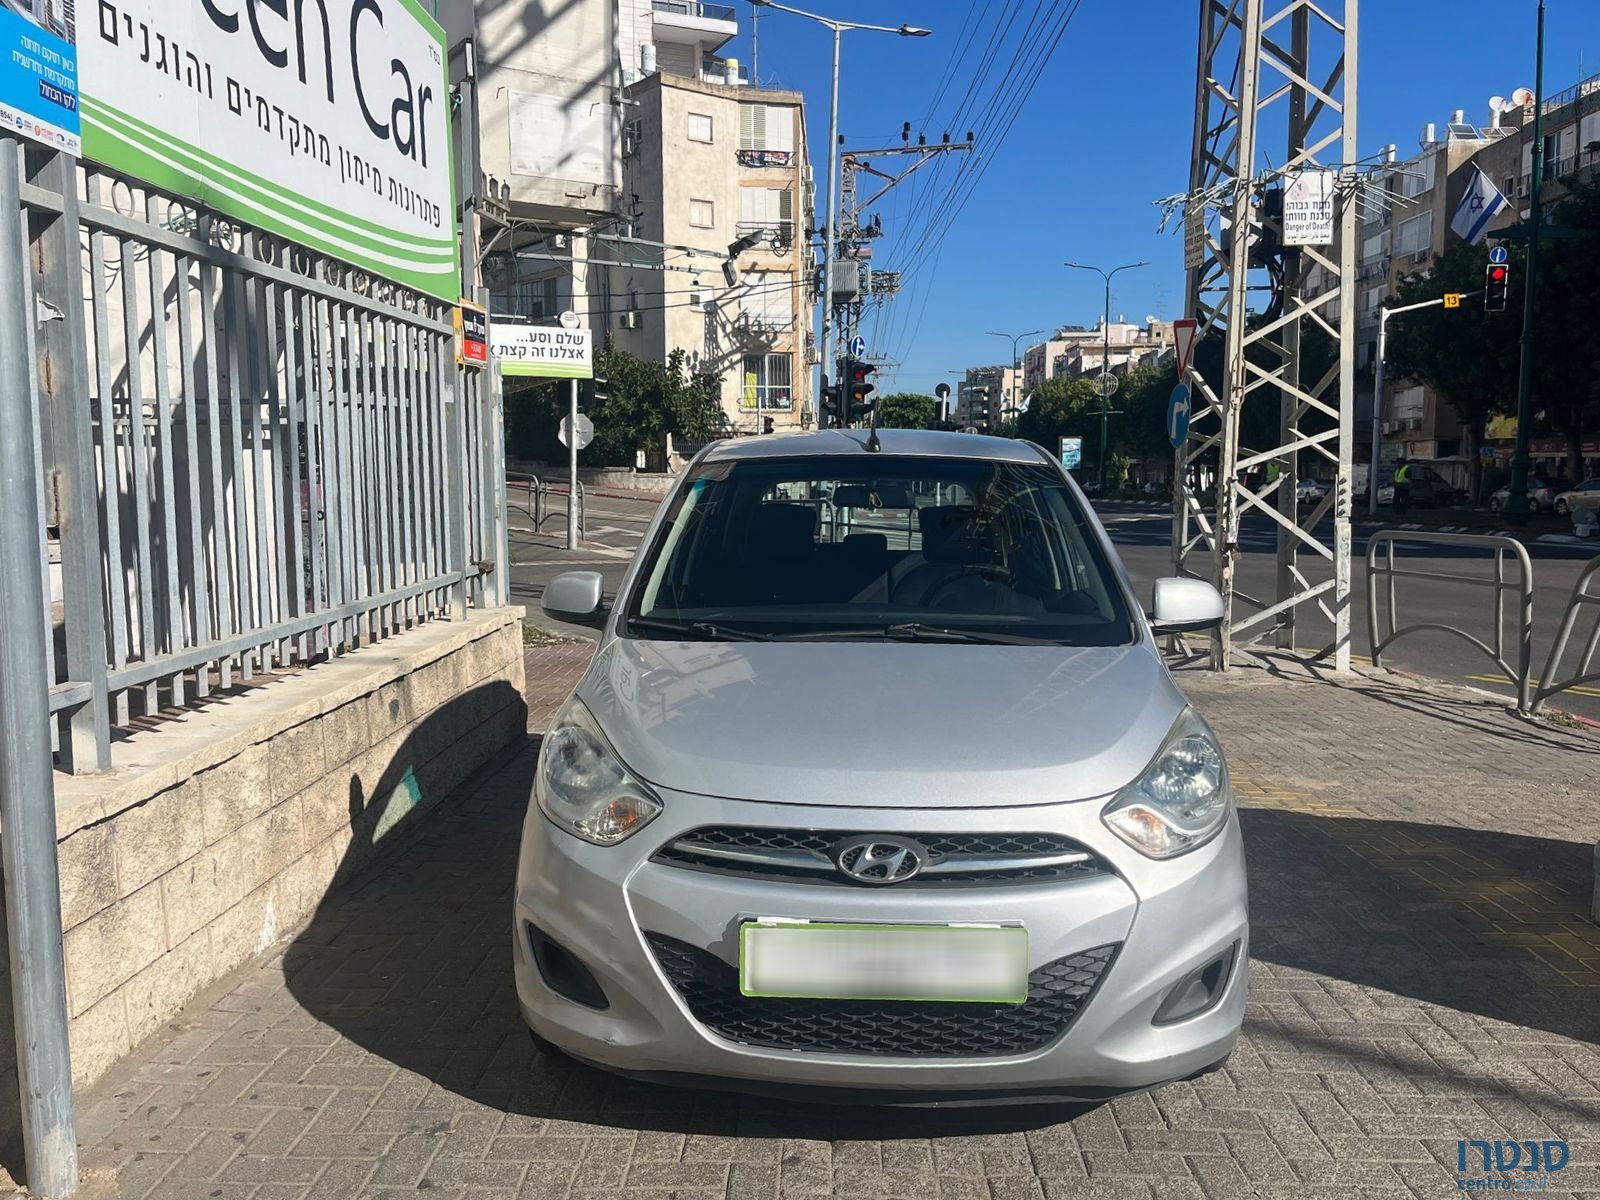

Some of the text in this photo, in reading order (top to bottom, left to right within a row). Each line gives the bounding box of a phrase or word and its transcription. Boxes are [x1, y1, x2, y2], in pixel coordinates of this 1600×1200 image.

[61, 56, 74, 71] כאן
[350, 0, 433, 168] Car
[40, 80, 76, 109] לקו הכחול
[98, 0, 441, 229] פתרונות מימון מתקדמים והוגנים
[1310, 211, 1331, 221] סכנת
[1285, 222, 1305, 232] Danger
[1306, 222, 1312, 231] of
[1446, 296, 1457, 305] 13
[516, 332, 584, 345] שלם וסע...
[499, 345, 527, 359] קצת
[531, 346, 546, 358] זה
[549, 346, 584, 359] אצלנו
